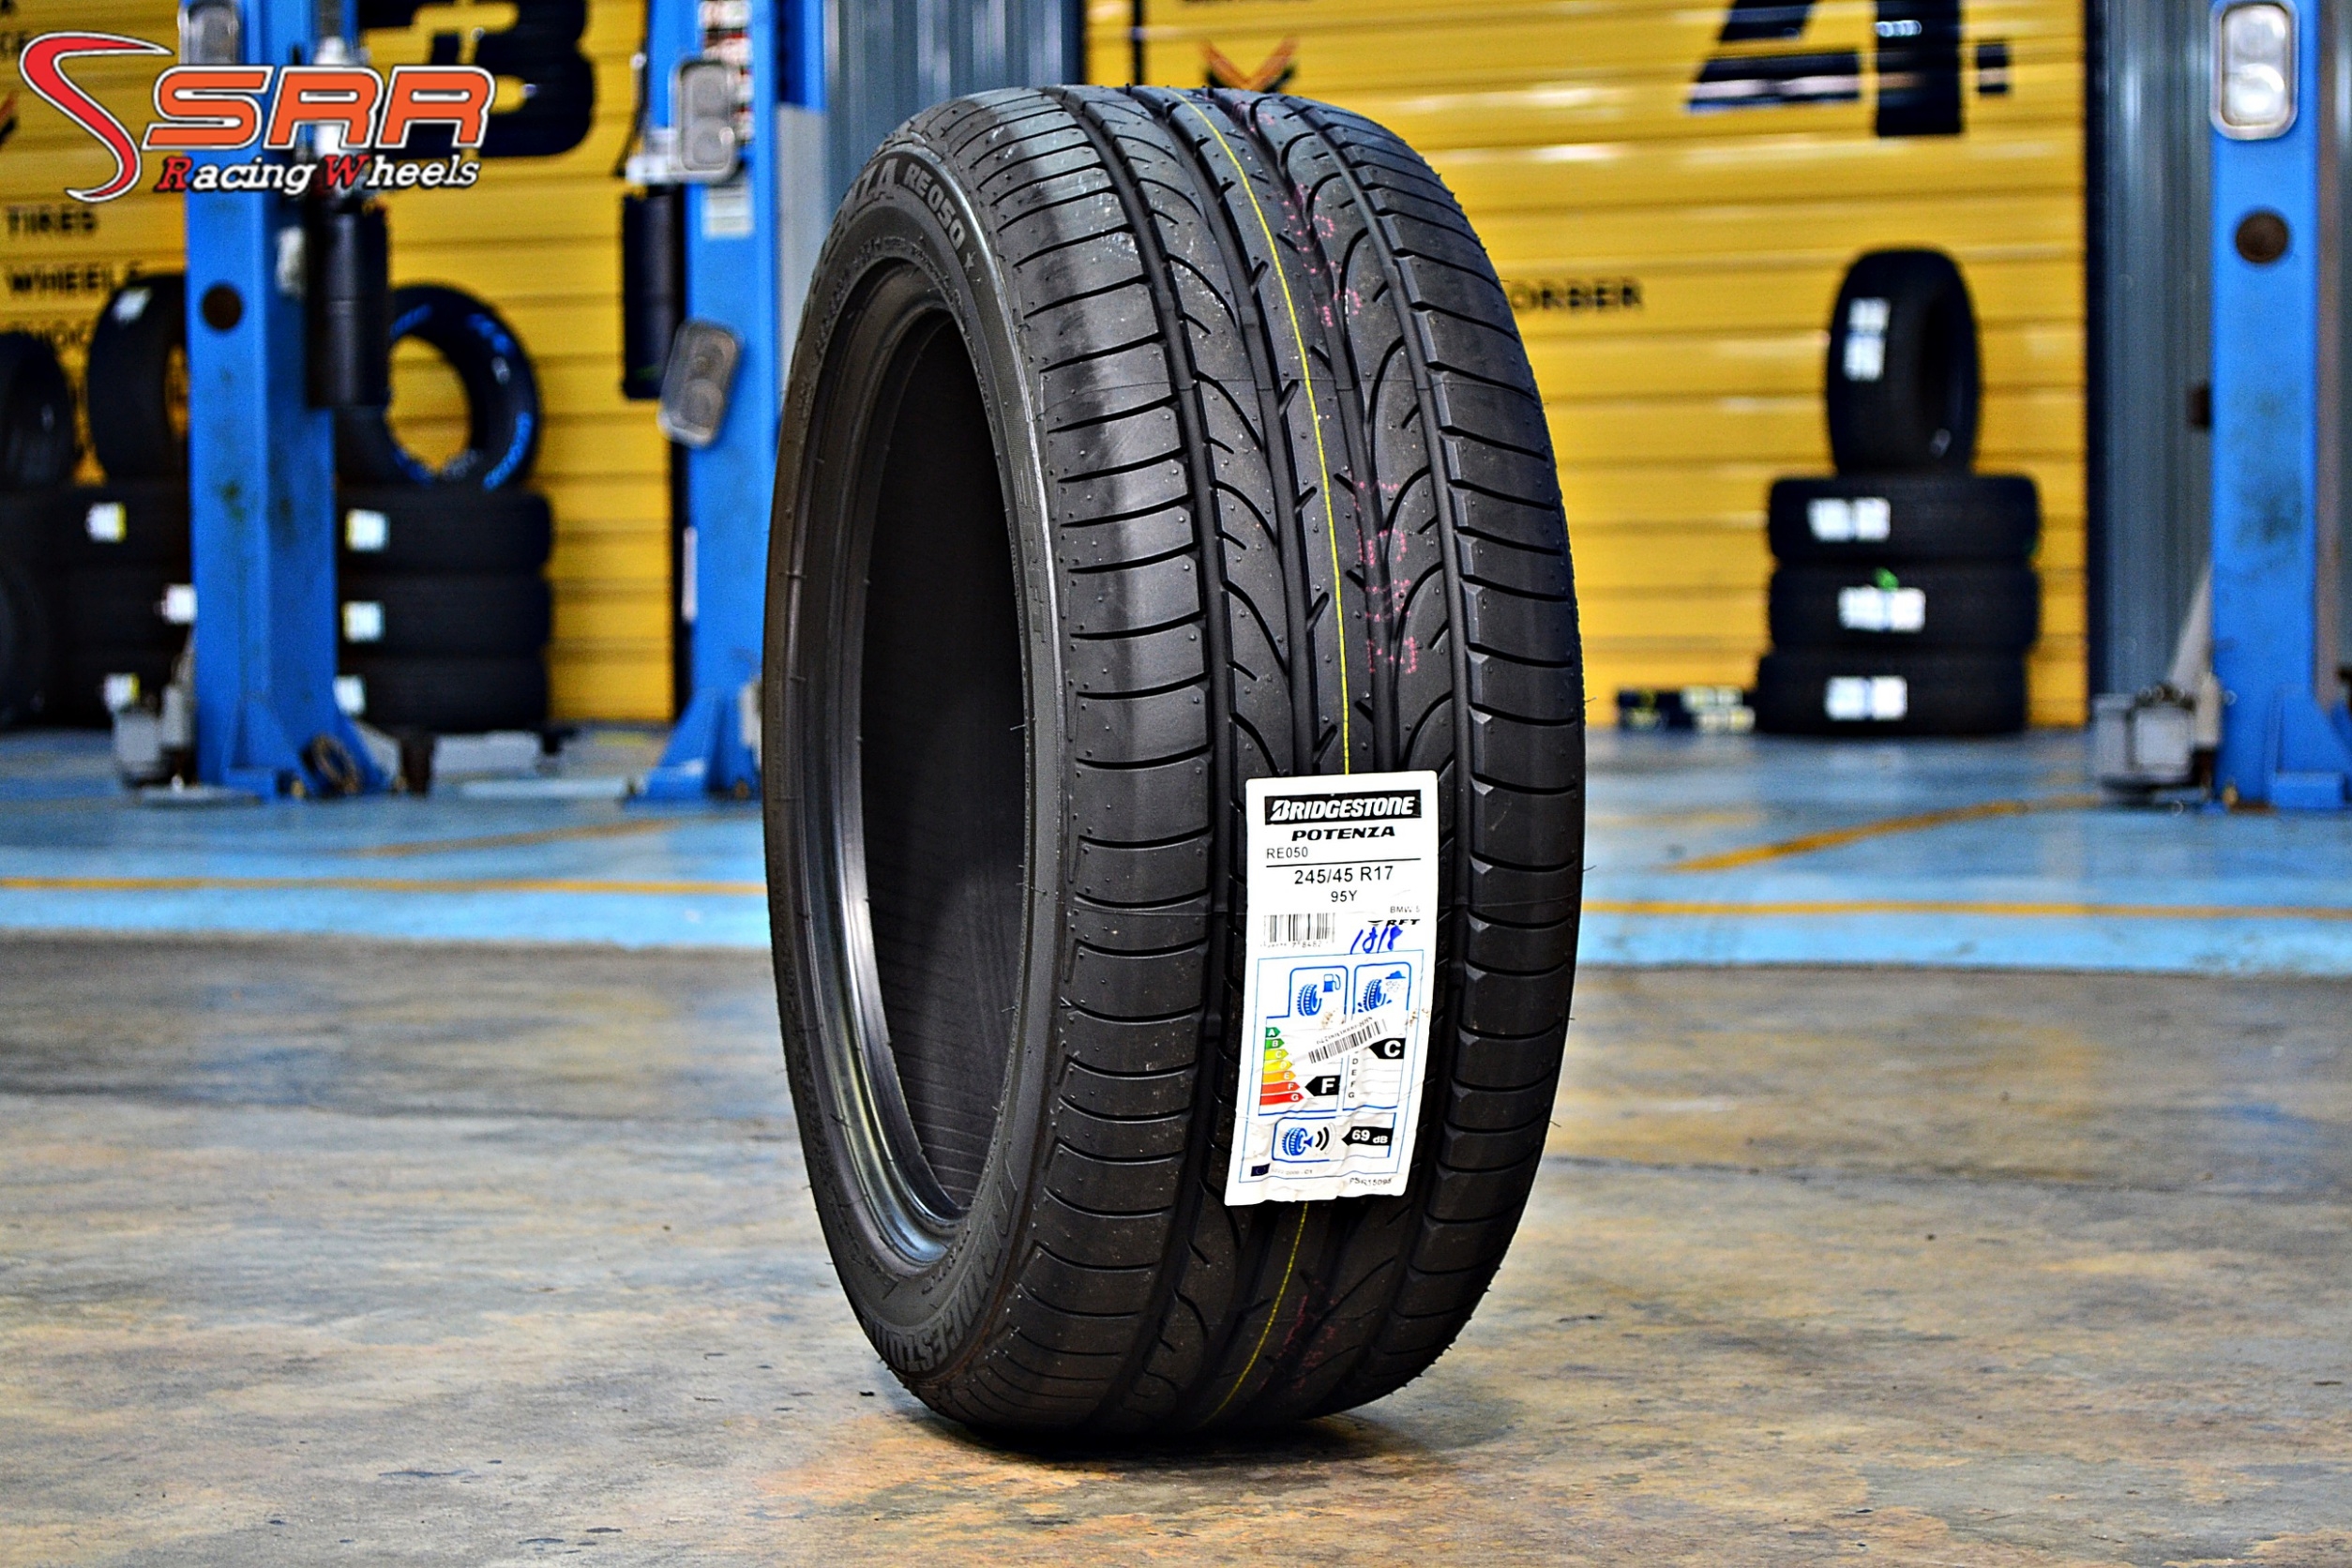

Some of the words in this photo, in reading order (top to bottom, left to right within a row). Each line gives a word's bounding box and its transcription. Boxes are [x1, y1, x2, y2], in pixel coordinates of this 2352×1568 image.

[1269, 795, 1416, 822] BRIDGESTONE
[1290, 825, 1396, 842] POTENZA
[1266, 846, 1309, 860] RE050
[1293, 867, 1354, 885] 245/45
[1359, 865, 1395, 882] R17
[1330, 889, 1359, 903] 95Y
[1383, 1039, 1402, 1058] C
[1320, 1078, 1336, 1094] F
[1351, 1129, 1371, 1142] 69
[1372, 1135, 1389, 1145] dB
